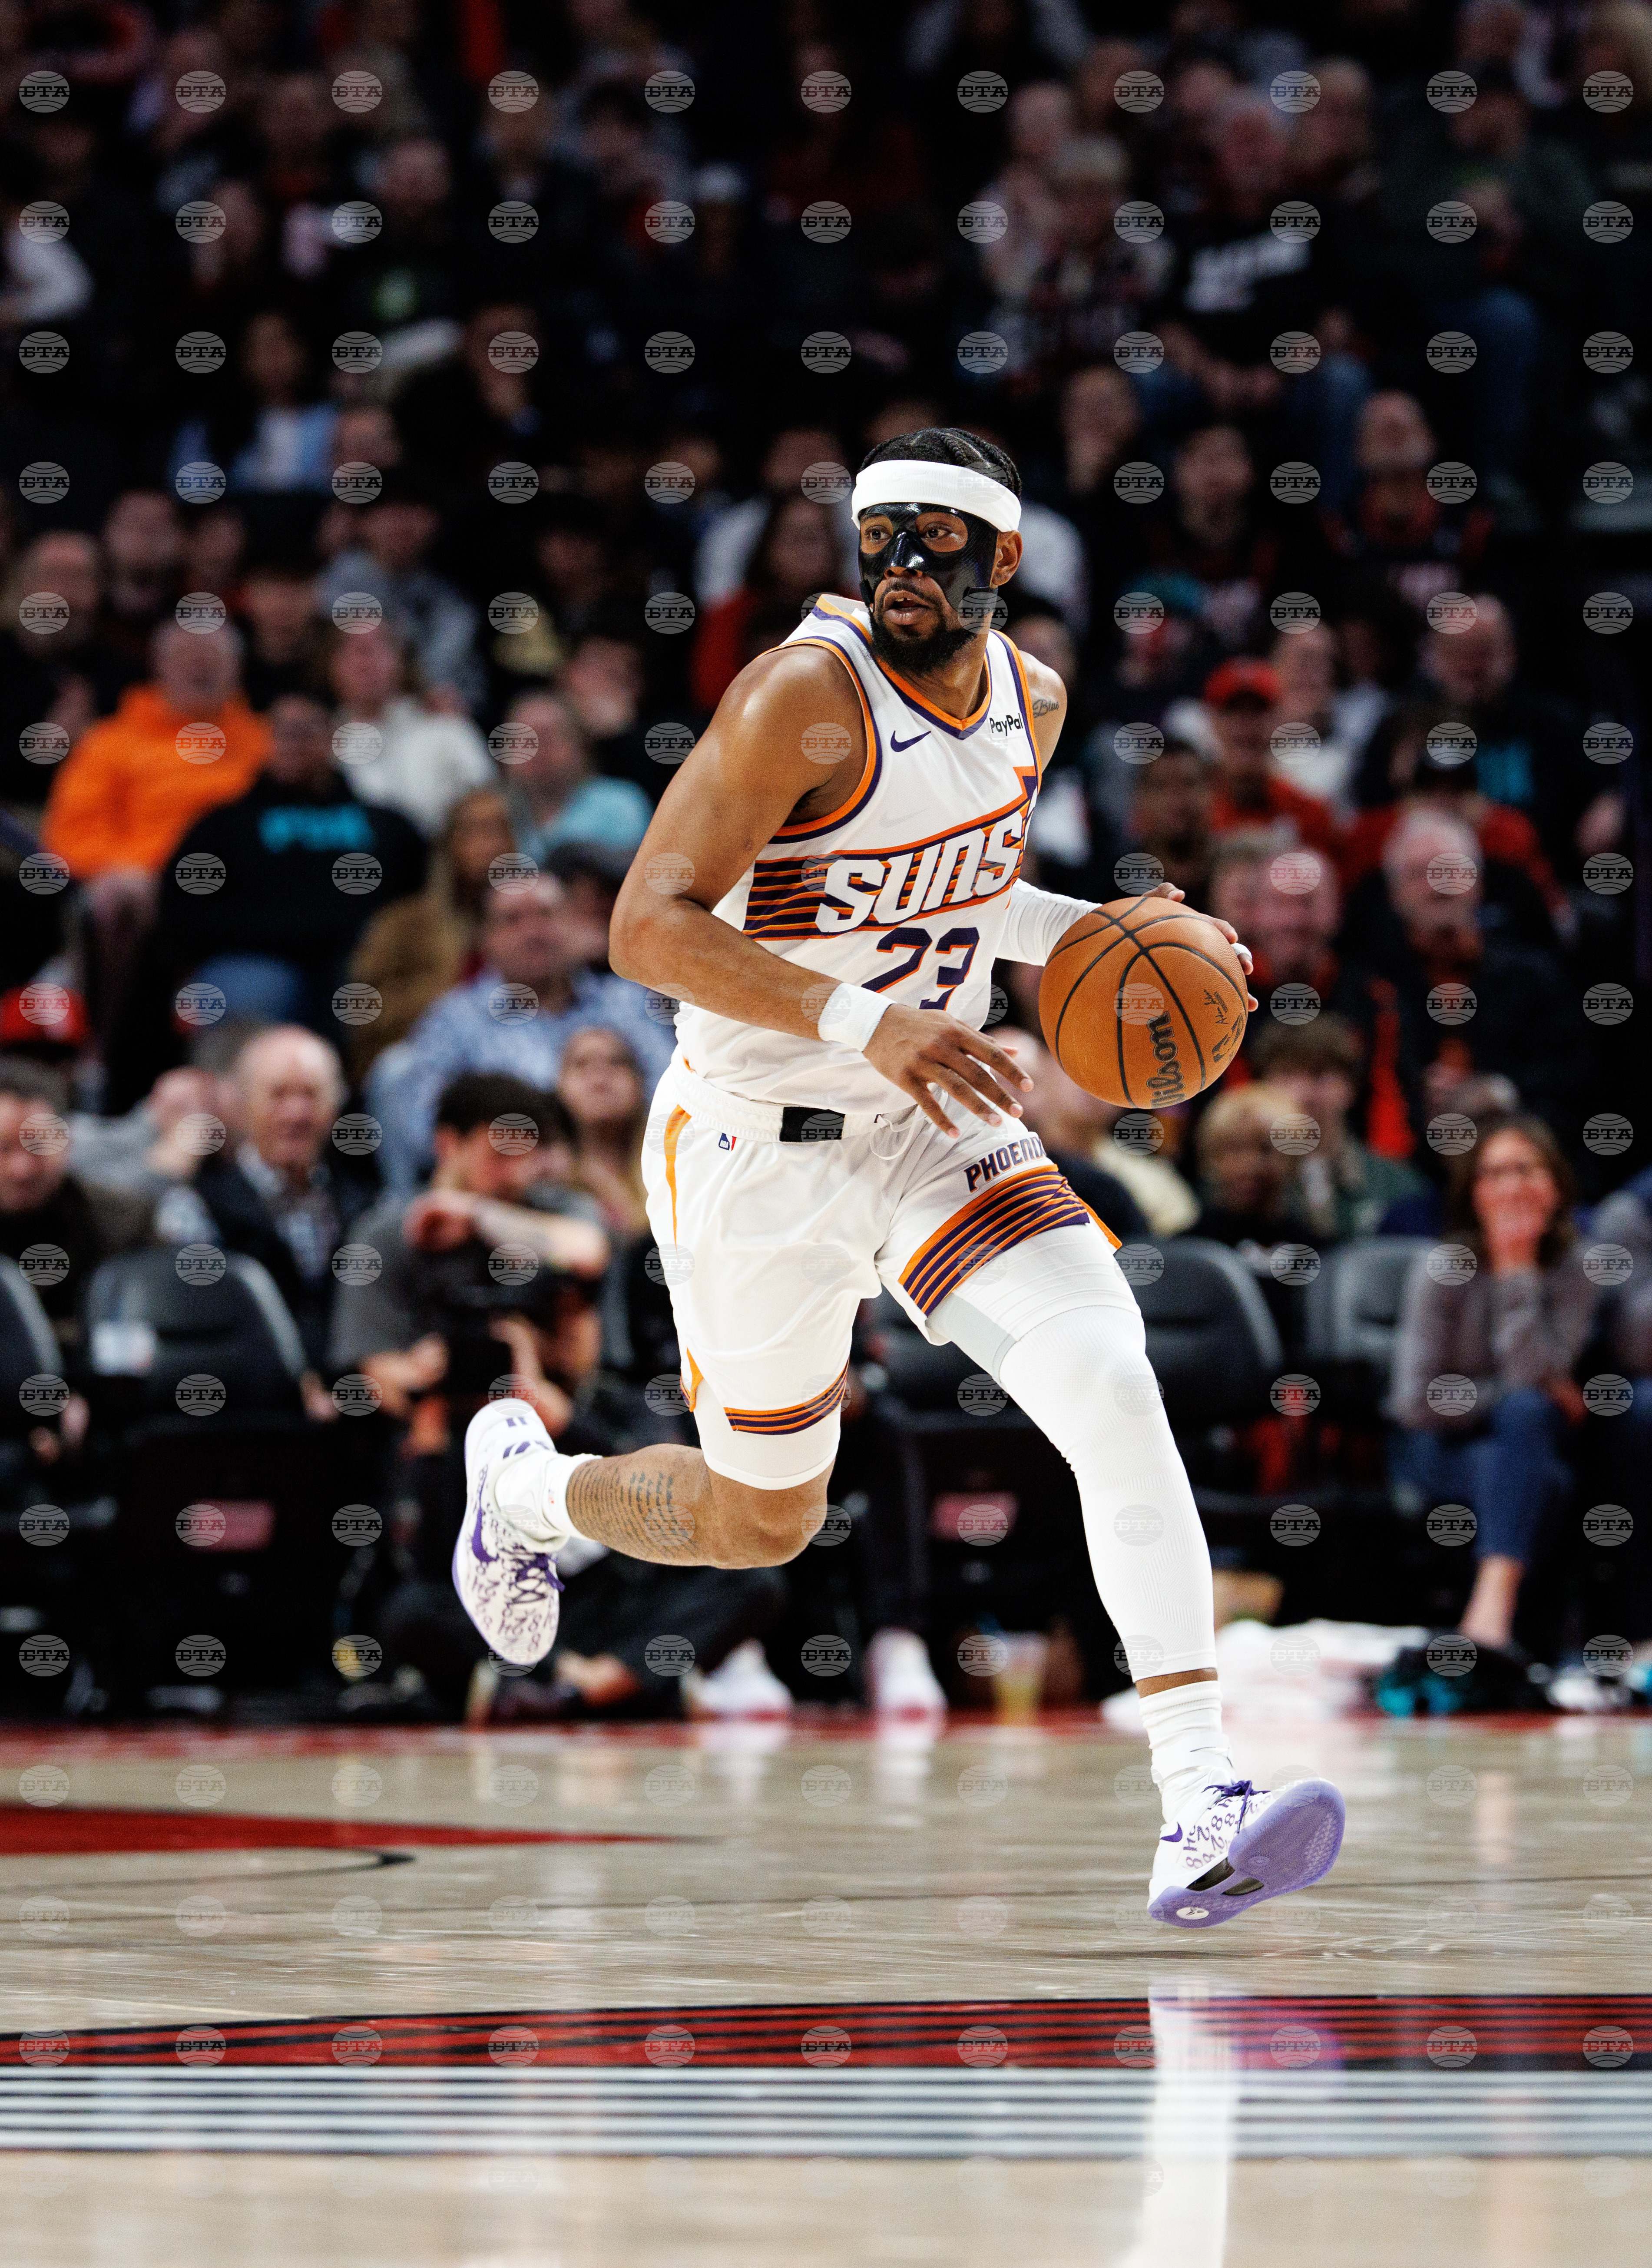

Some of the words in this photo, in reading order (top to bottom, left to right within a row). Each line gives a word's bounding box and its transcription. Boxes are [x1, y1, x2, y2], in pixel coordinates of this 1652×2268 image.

[989, 712, 1023, 737] PayPal
[815, 810, 1023, 933] SUNS
[861, 927, 980, 1012] 23
[719, 1140, 729, 1149] NBA
